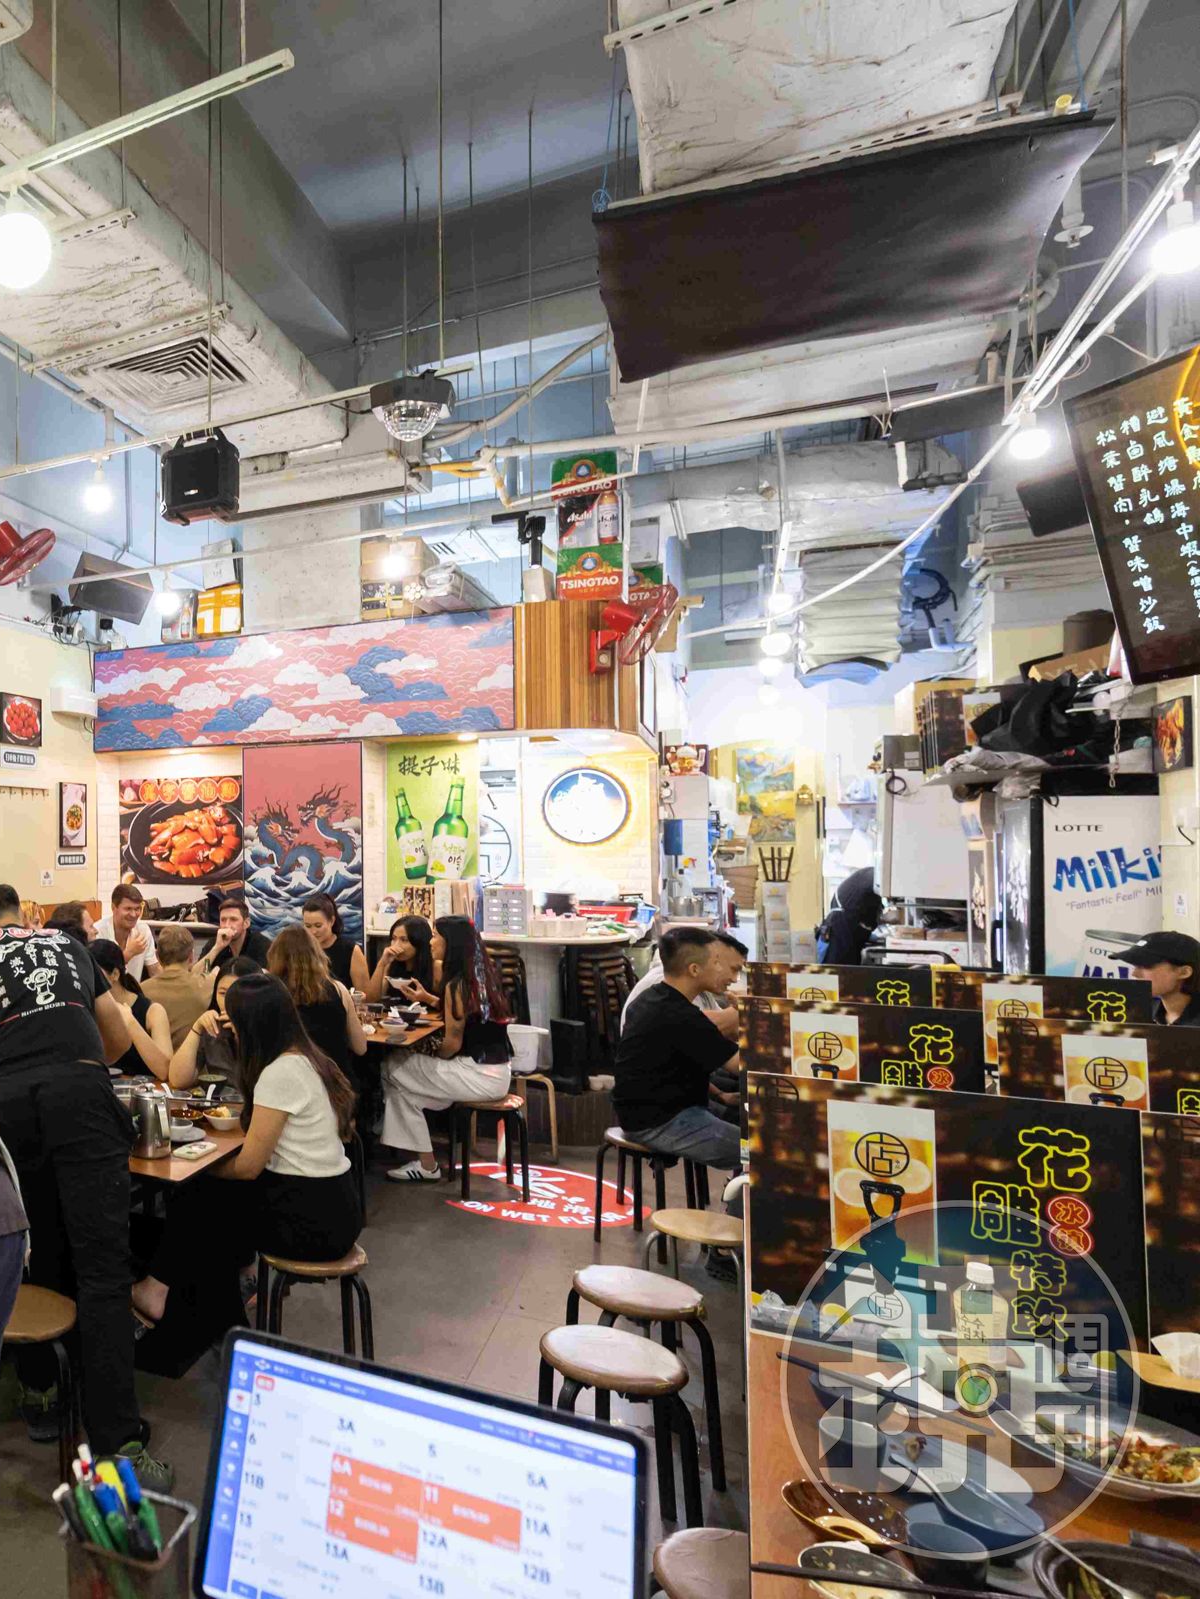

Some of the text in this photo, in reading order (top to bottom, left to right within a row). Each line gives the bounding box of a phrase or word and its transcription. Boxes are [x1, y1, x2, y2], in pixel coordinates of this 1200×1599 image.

[560, 575, 619, 589] TSINGTAO
[398, 754, 461, 776] 提子味
[1055, 824, 1103, 832] LOTTE
[1053, 847, 1162, 893] Milki
[502, 1210, 549, 1222] WET
